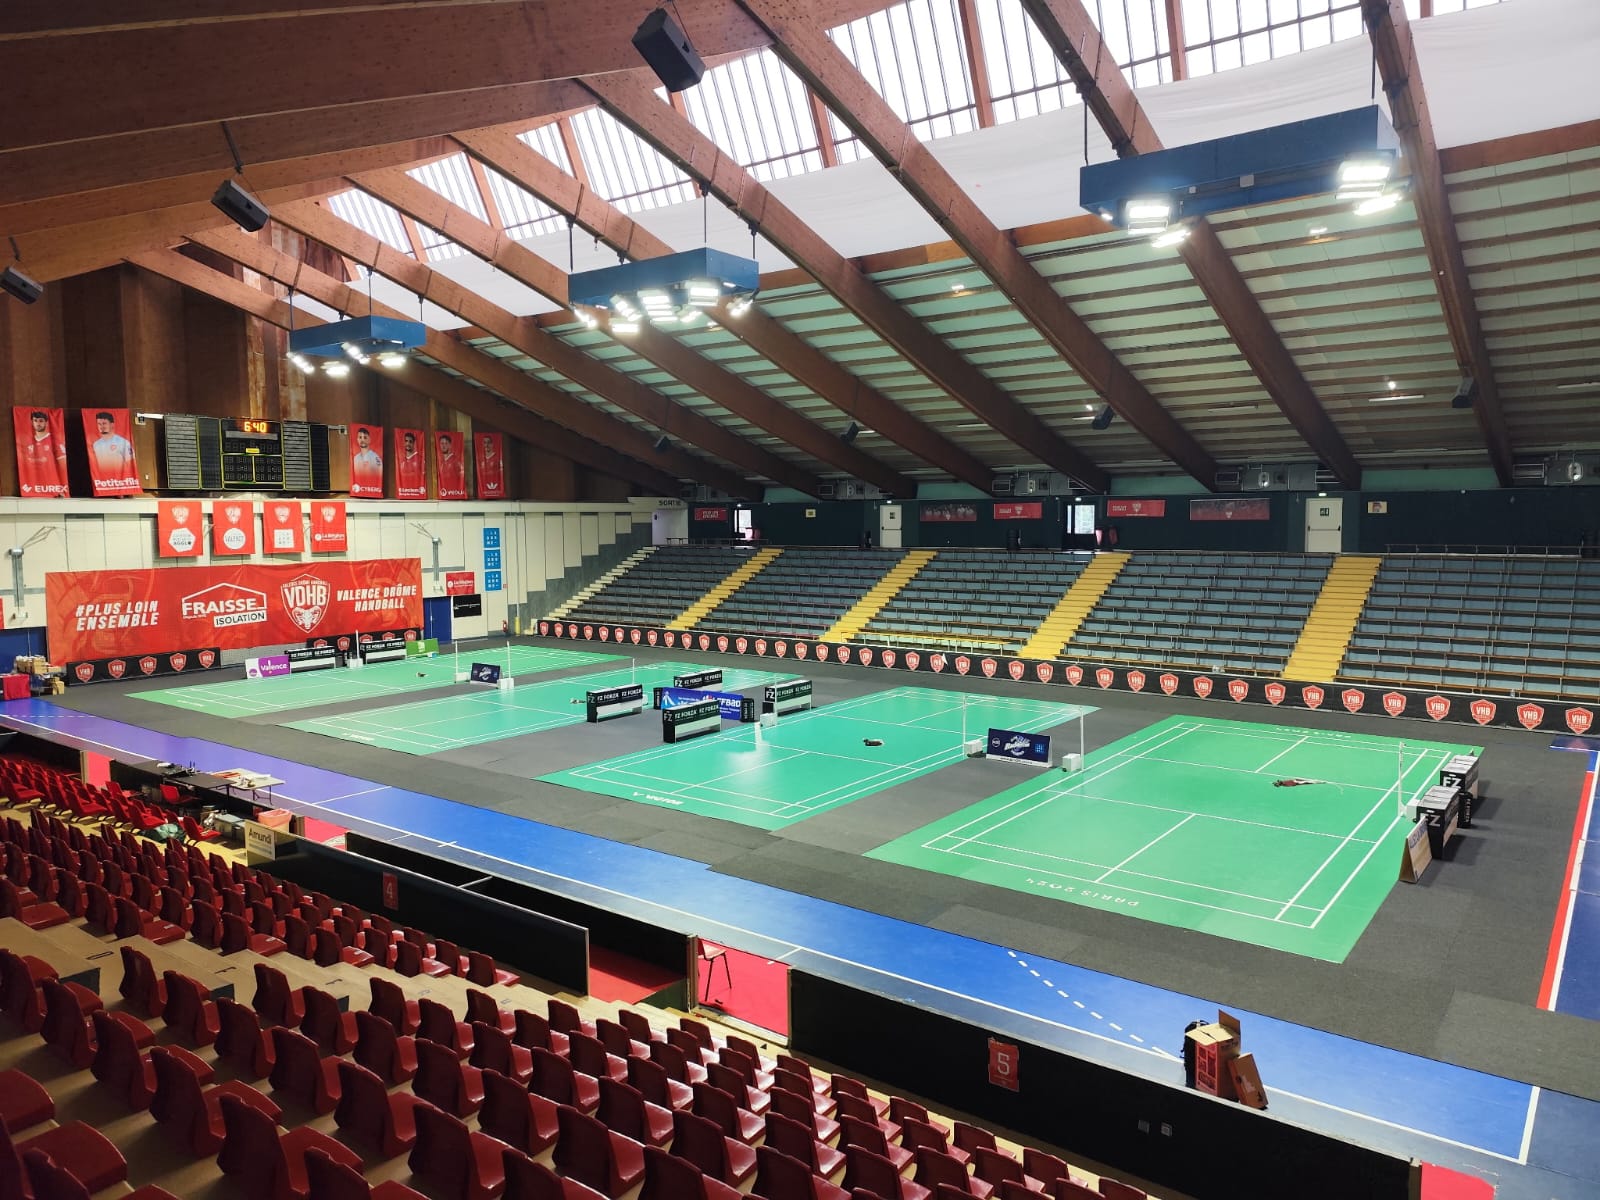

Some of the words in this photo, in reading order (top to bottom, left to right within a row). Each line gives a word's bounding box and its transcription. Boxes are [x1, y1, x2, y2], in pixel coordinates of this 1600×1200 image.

[284, 585, 326, 608] VDHB
[337, 588, 380, 601] VALENCE
[384, 584, 416, 597] DRÔME
[76, 602, 121, 617] #PLUS
[126, 600, 158, 614] LOIN
[182, 598, 257, 616] FRAISSE
[355, 598, 404, 612] HANDBALL
[77, 612, 159, 631] ENSEMBLE
[216, 612, 264, 625] ISOLATION
[261, 660, 288, 672] Valence
[1389, 700, 1401, 708] VHB
[1431, 703, 1445, 711] VHB
[664, 712, 672, 722] FZ
[1476, 707, 1490, 716] VHB
[1524, 711, 1538, 720] VHB
[1572, 715, 1586, 724] VHB
[1443, 777, 1462, 789] FZ
[1080, 890, 1139, 906] PARIS
[998, 1052, 1010, 1075] 5
